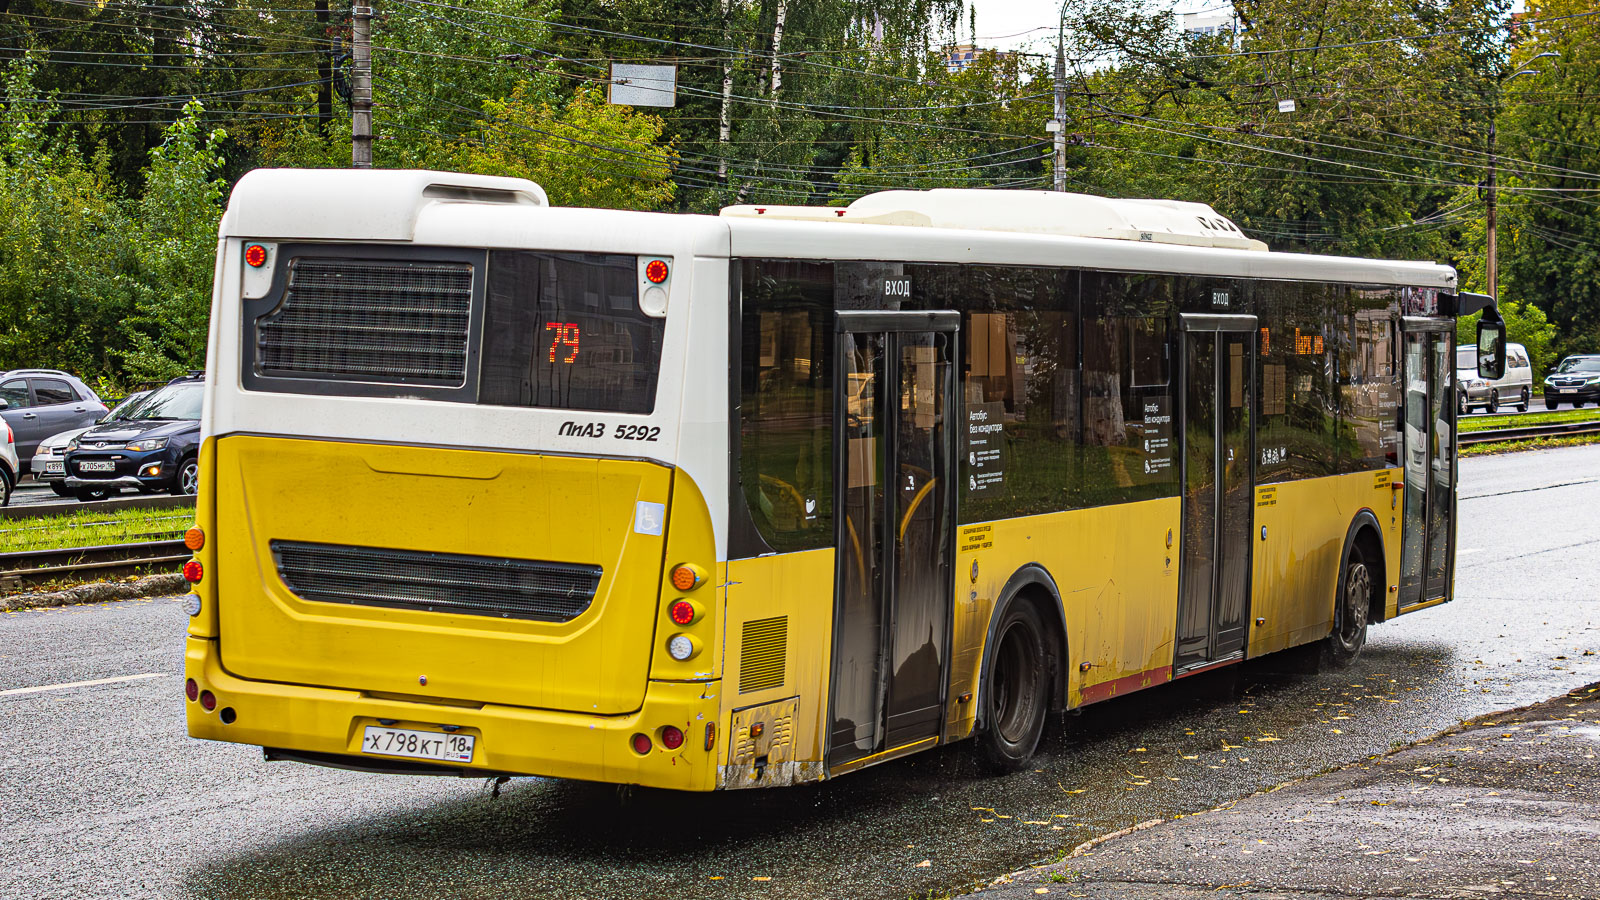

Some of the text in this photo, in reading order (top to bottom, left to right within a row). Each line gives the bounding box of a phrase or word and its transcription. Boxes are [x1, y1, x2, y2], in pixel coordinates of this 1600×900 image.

[885, 280, 910, 298] ВХОД
[1212, 292, 1229, 307] ВХОД
[545, 322, 580, 364] 79
[969, 409, 988, 422] Автобус
[558, 421, 661, 442] ЛиАЗ 5292
[449, 736, 467, 752] 18
